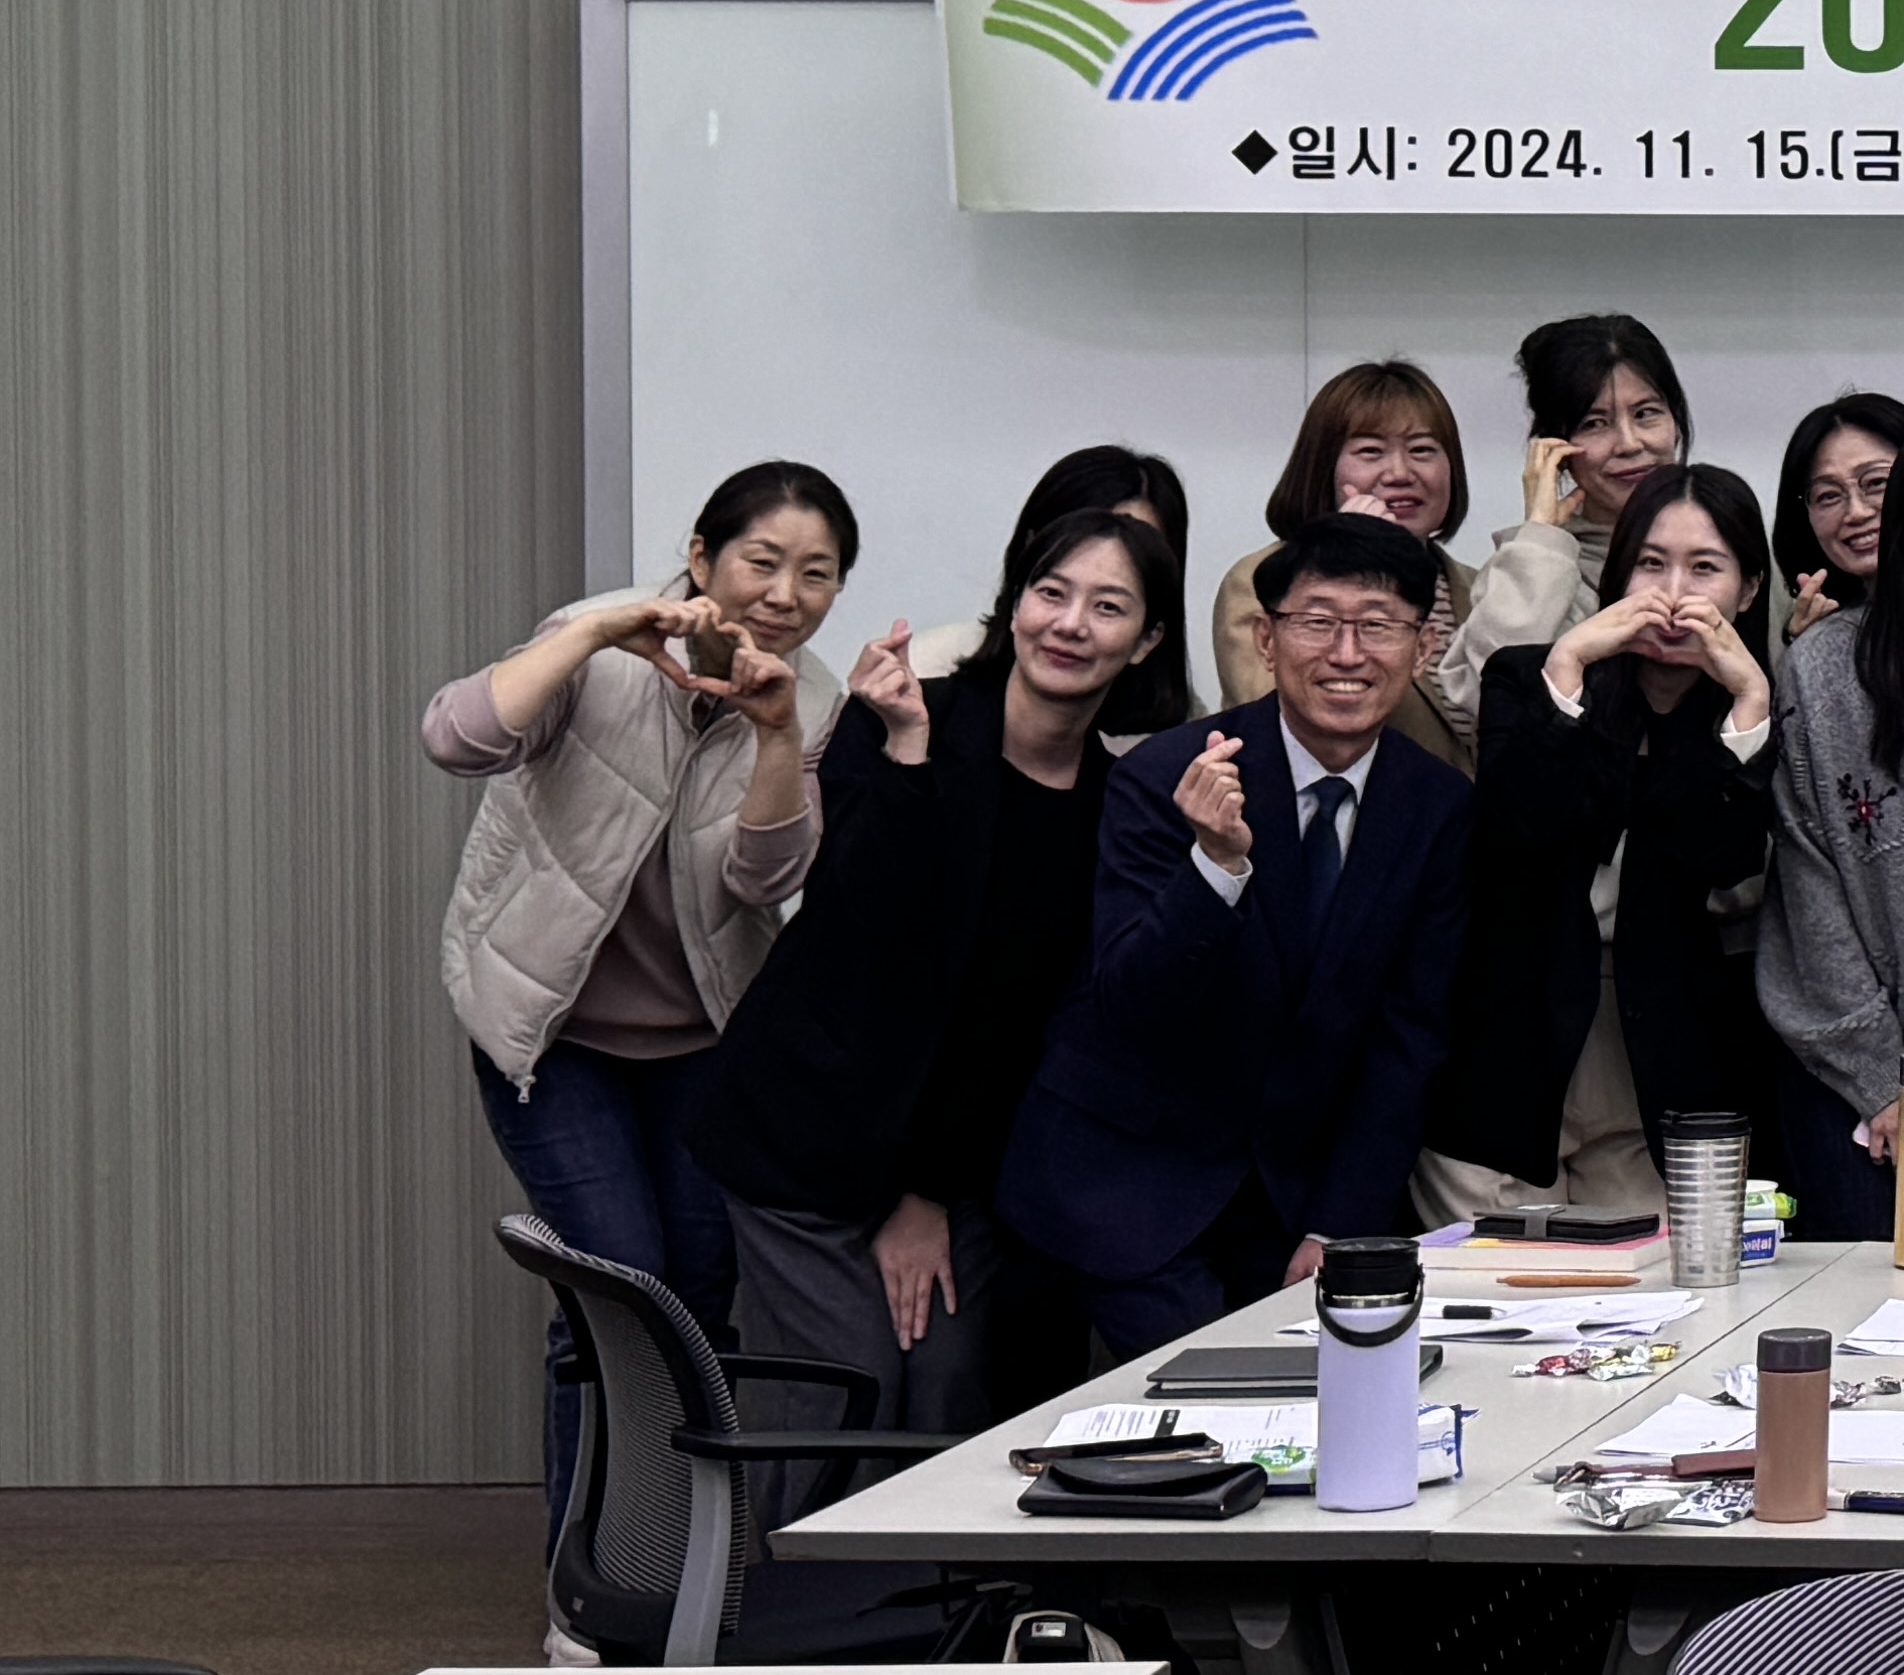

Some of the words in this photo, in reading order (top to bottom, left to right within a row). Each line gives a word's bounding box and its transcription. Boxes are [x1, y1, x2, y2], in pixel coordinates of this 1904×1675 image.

[1288, 126, 1417, 181] 일시:
[1448, 128, 1602, 179] 2024.
[1636, 130, 1714, 179] 11.
